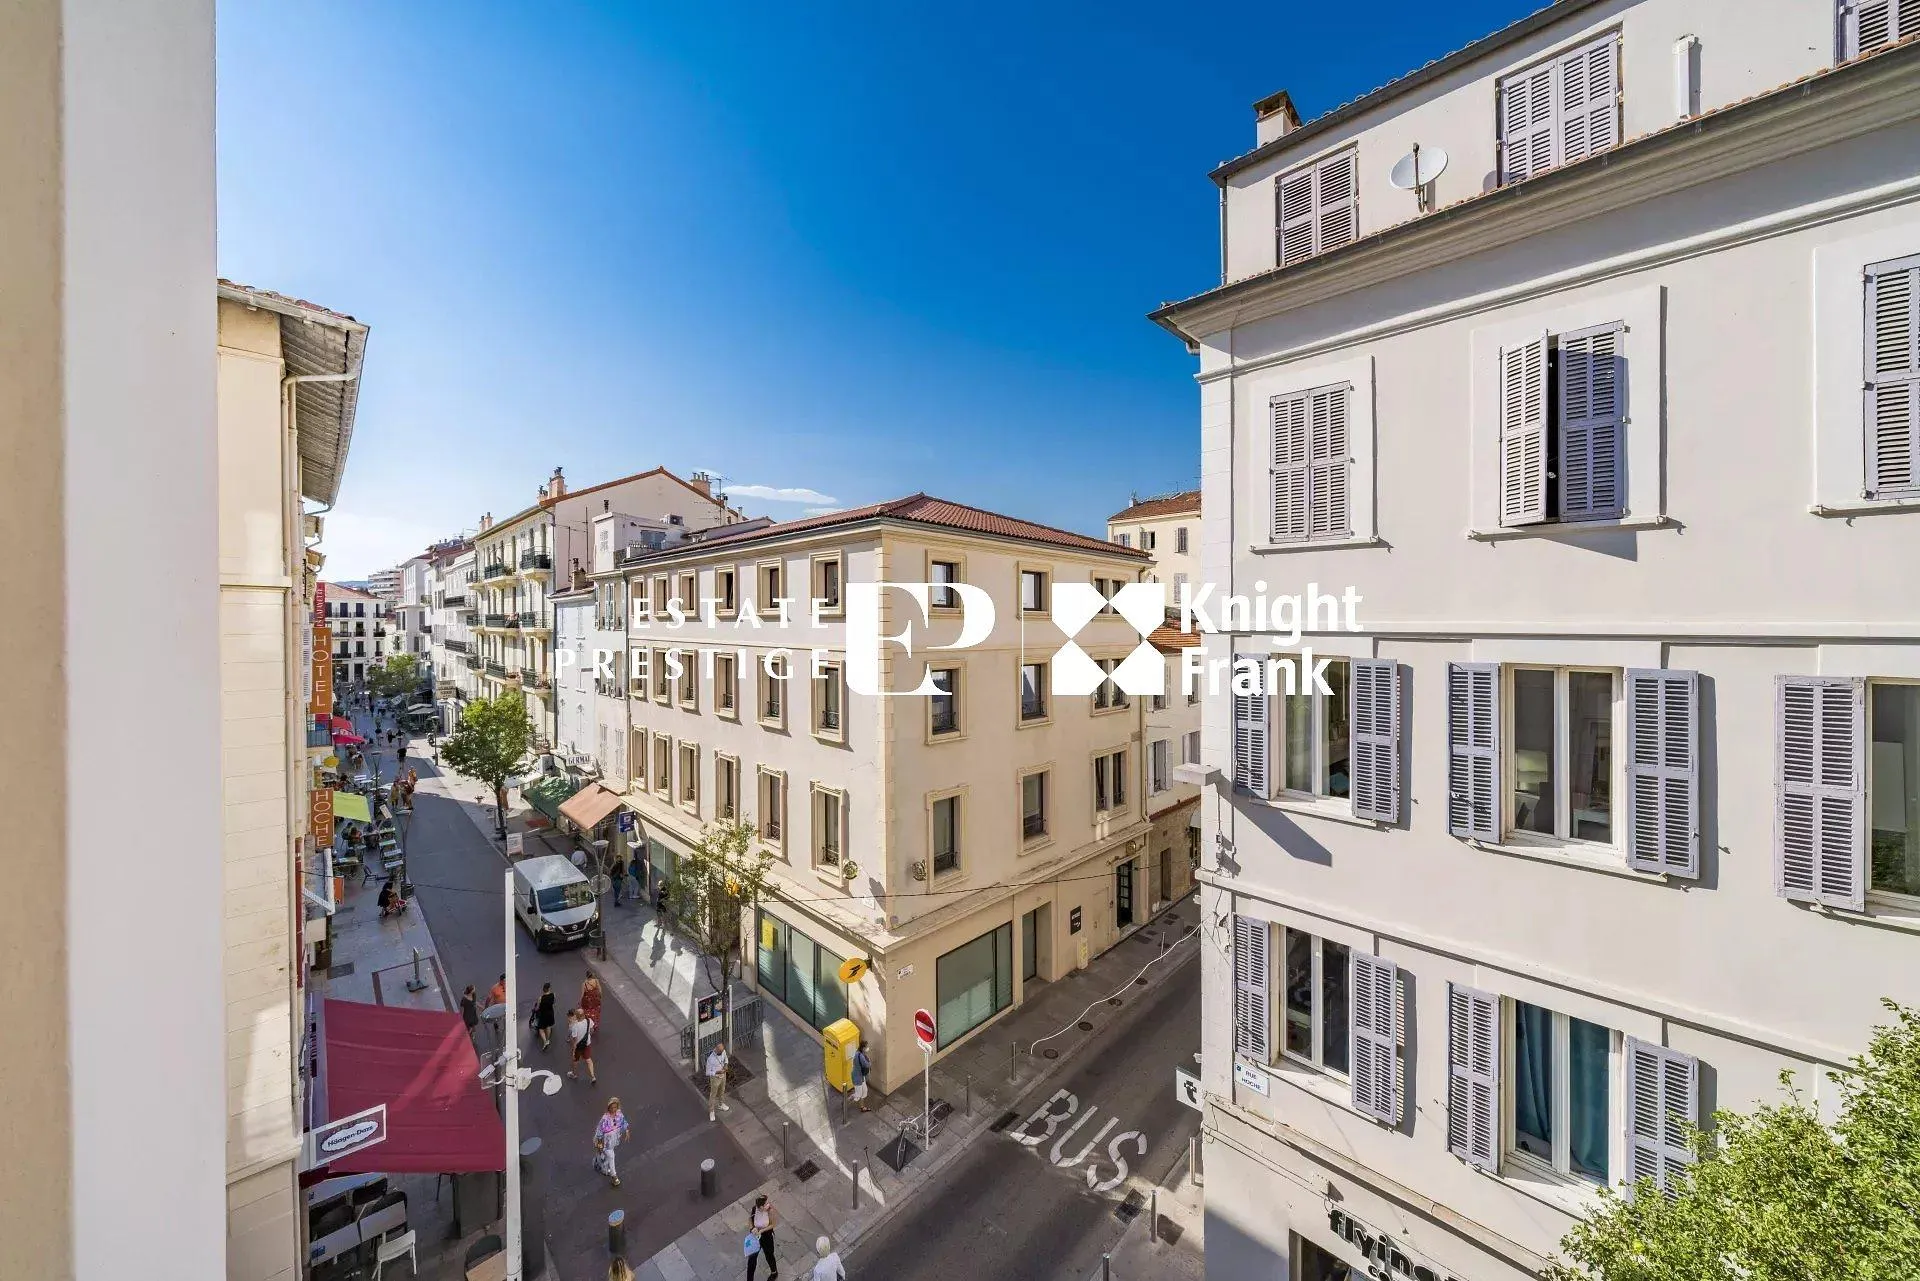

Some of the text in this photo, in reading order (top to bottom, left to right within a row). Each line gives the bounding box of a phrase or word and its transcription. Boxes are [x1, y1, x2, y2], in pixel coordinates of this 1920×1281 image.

[312, 635, 329, 706] HOTEL
[314, 790, 331, 847] HOCHE
[1241, 1077, 1262, 1091] HOCHE
[1245, 1070, 1257, 1080] RUE
[1010, 1088, 1148, 1191] BUS
